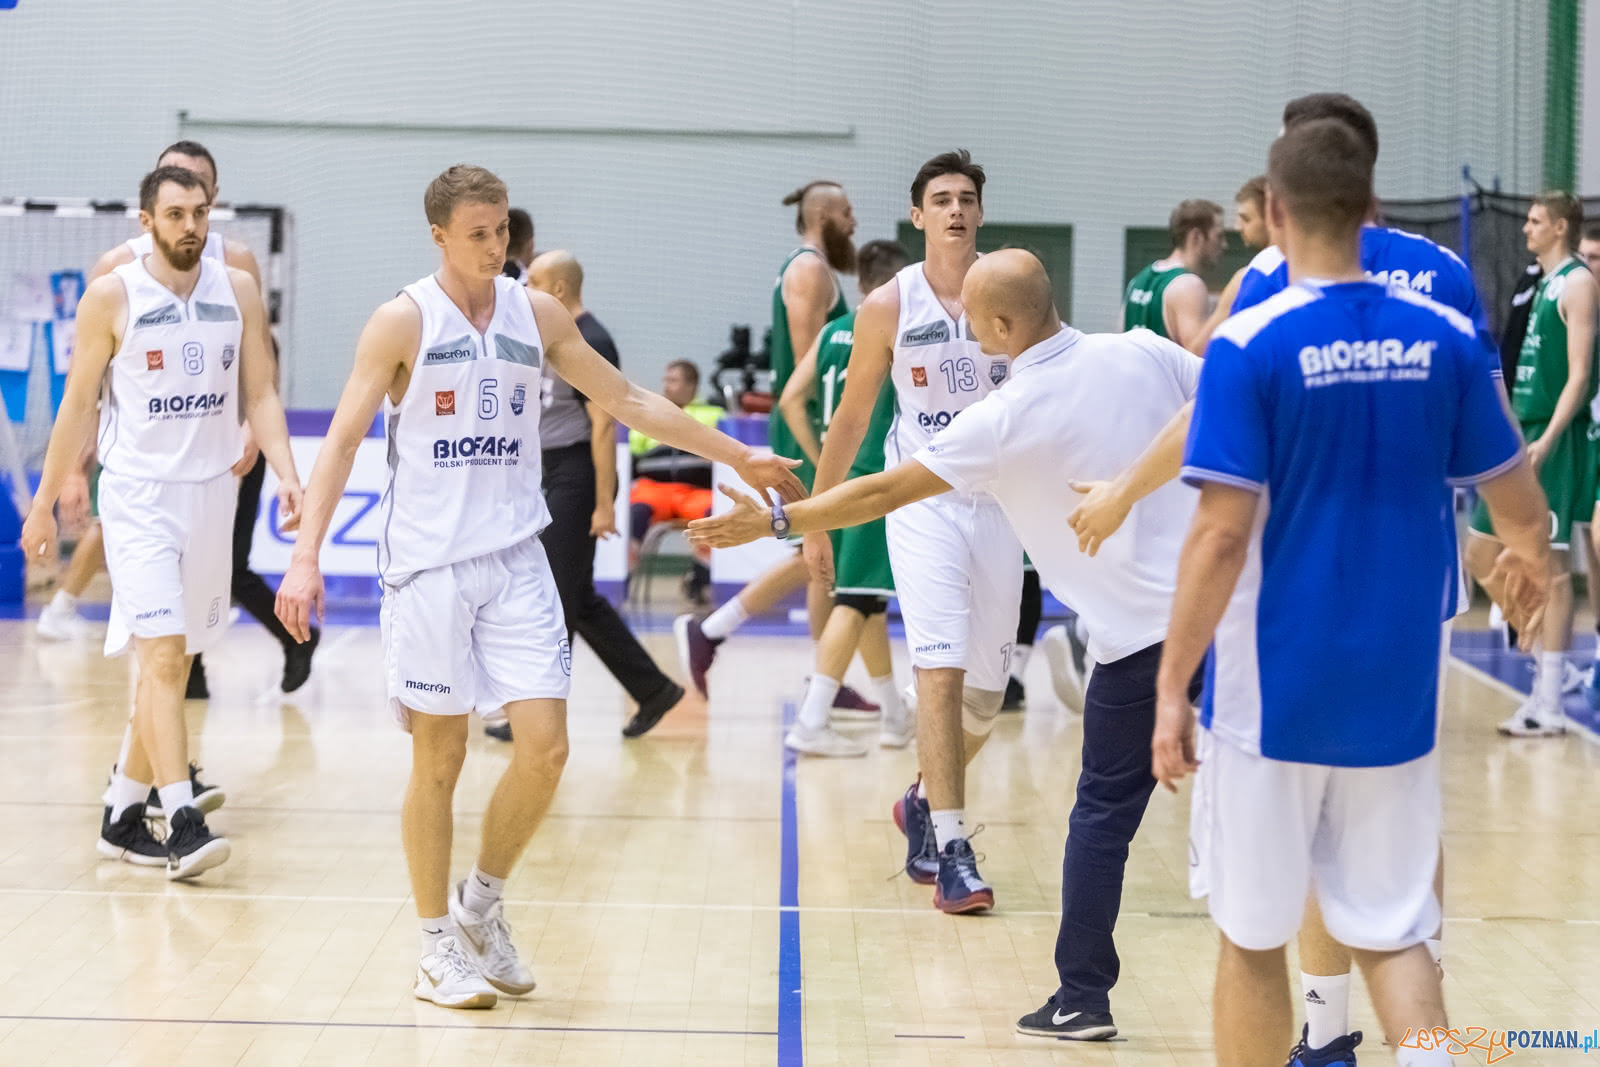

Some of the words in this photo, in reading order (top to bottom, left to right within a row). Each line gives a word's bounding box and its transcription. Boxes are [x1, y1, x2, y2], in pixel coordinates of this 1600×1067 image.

[906, 330, 945, 343] macron
[182, 341, 204, 376] 8
[427, 349, 470, 361] macron
[1299, 338, 1432, 376] BIOFARM
[940, 357, 979, 393] 13
[149, 392, 225, 413] BIOFARM
[478, 378, 499, 420] 6
[433, 436, 520, 459] BIOFARM
[136, 607, 172, 620] macron
[915, 641, 951, 653] macron
[406, 679, 451, 694] macron
